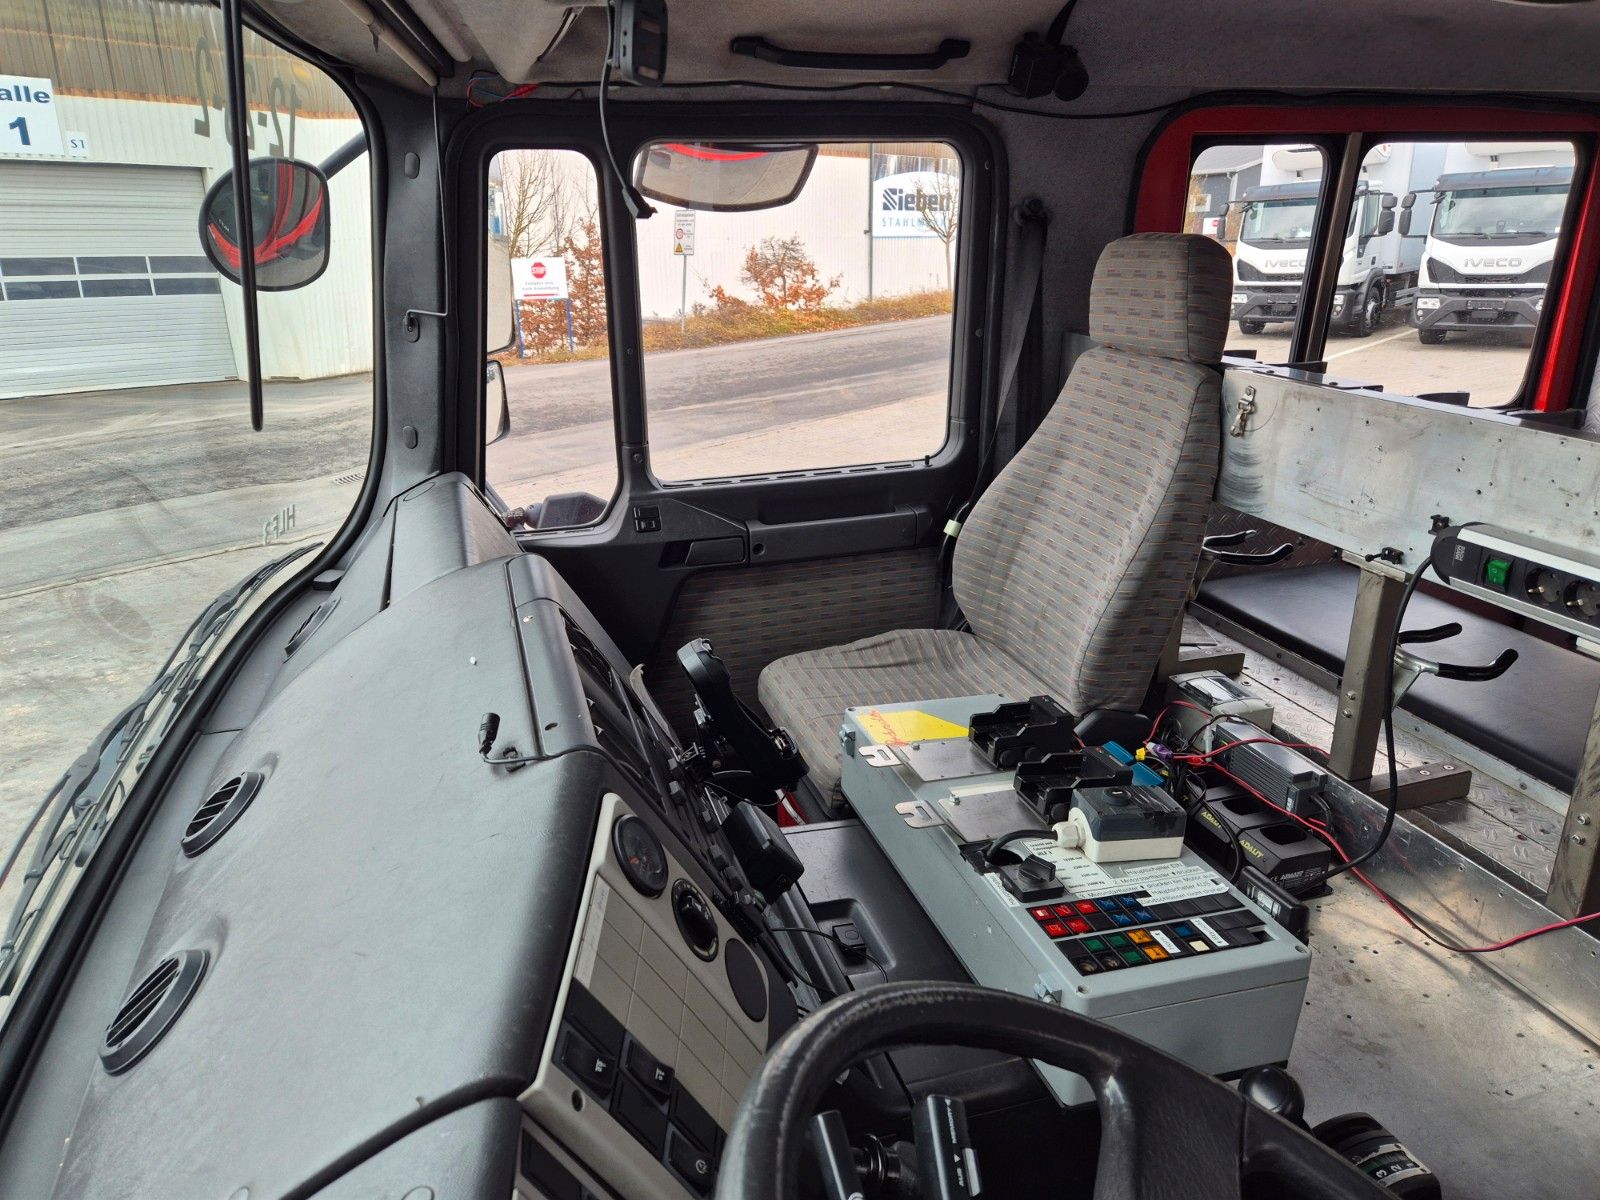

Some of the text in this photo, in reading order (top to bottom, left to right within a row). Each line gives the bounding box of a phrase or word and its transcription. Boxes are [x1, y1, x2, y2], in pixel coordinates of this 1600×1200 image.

[0, 84, 51, 104] alle
[8, 116, 32, 146] 1
[1464, 257, 1523, 268] IVECO
[1239, 839, 1264, 859] ADALIT
